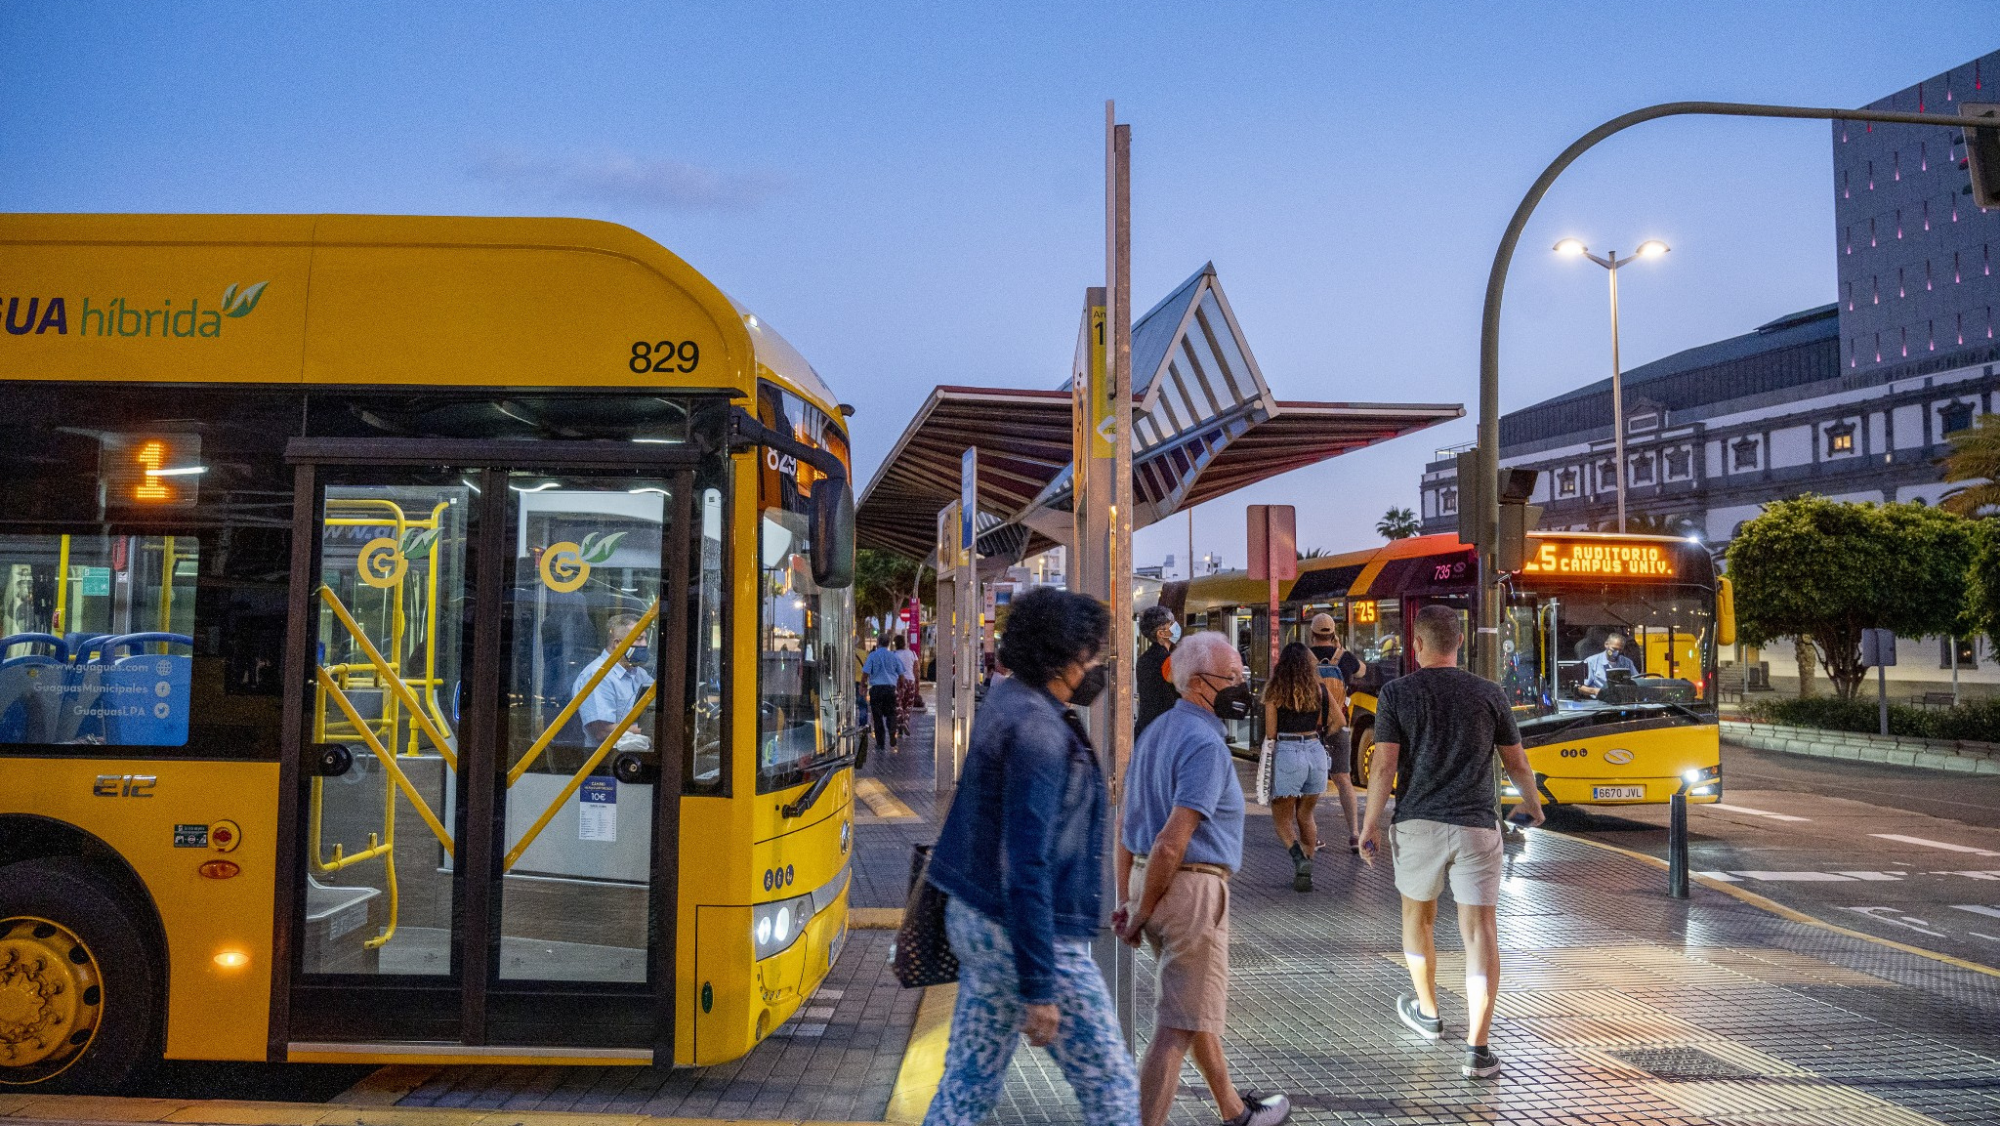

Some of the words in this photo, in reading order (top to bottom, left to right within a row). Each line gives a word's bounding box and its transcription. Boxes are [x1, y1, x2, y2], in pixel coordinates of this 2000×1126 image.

[0, 297, 67, 335] UA
[81, 297, 222, 338] híbrida
[1093, 310, 1106, 318] An
[629, 340, 700, 373] 829
[136, 443, 167, 498] 1
[1573, 546, 1659, 562] AUDITORIO
[1434, 564, 1452, 580] 735
[1560, 557, 1622, 573] CAMPUS
[1629, 560, 1673, 574] UNIV.
[1360, 601, 1375, 622] 25
[48, 663, 149, 673] www.guaguas.com
[33, 683, 149, 695] GuaguasMunicipales
[73, 705, 146, 718] GuaguasLPA
[93, 774, 157, 797] E12
[1599, 788, 1622, 798] 6670
[1625, 788, 1642, 798] JVL
[591, 792, 606, 802] 10€
